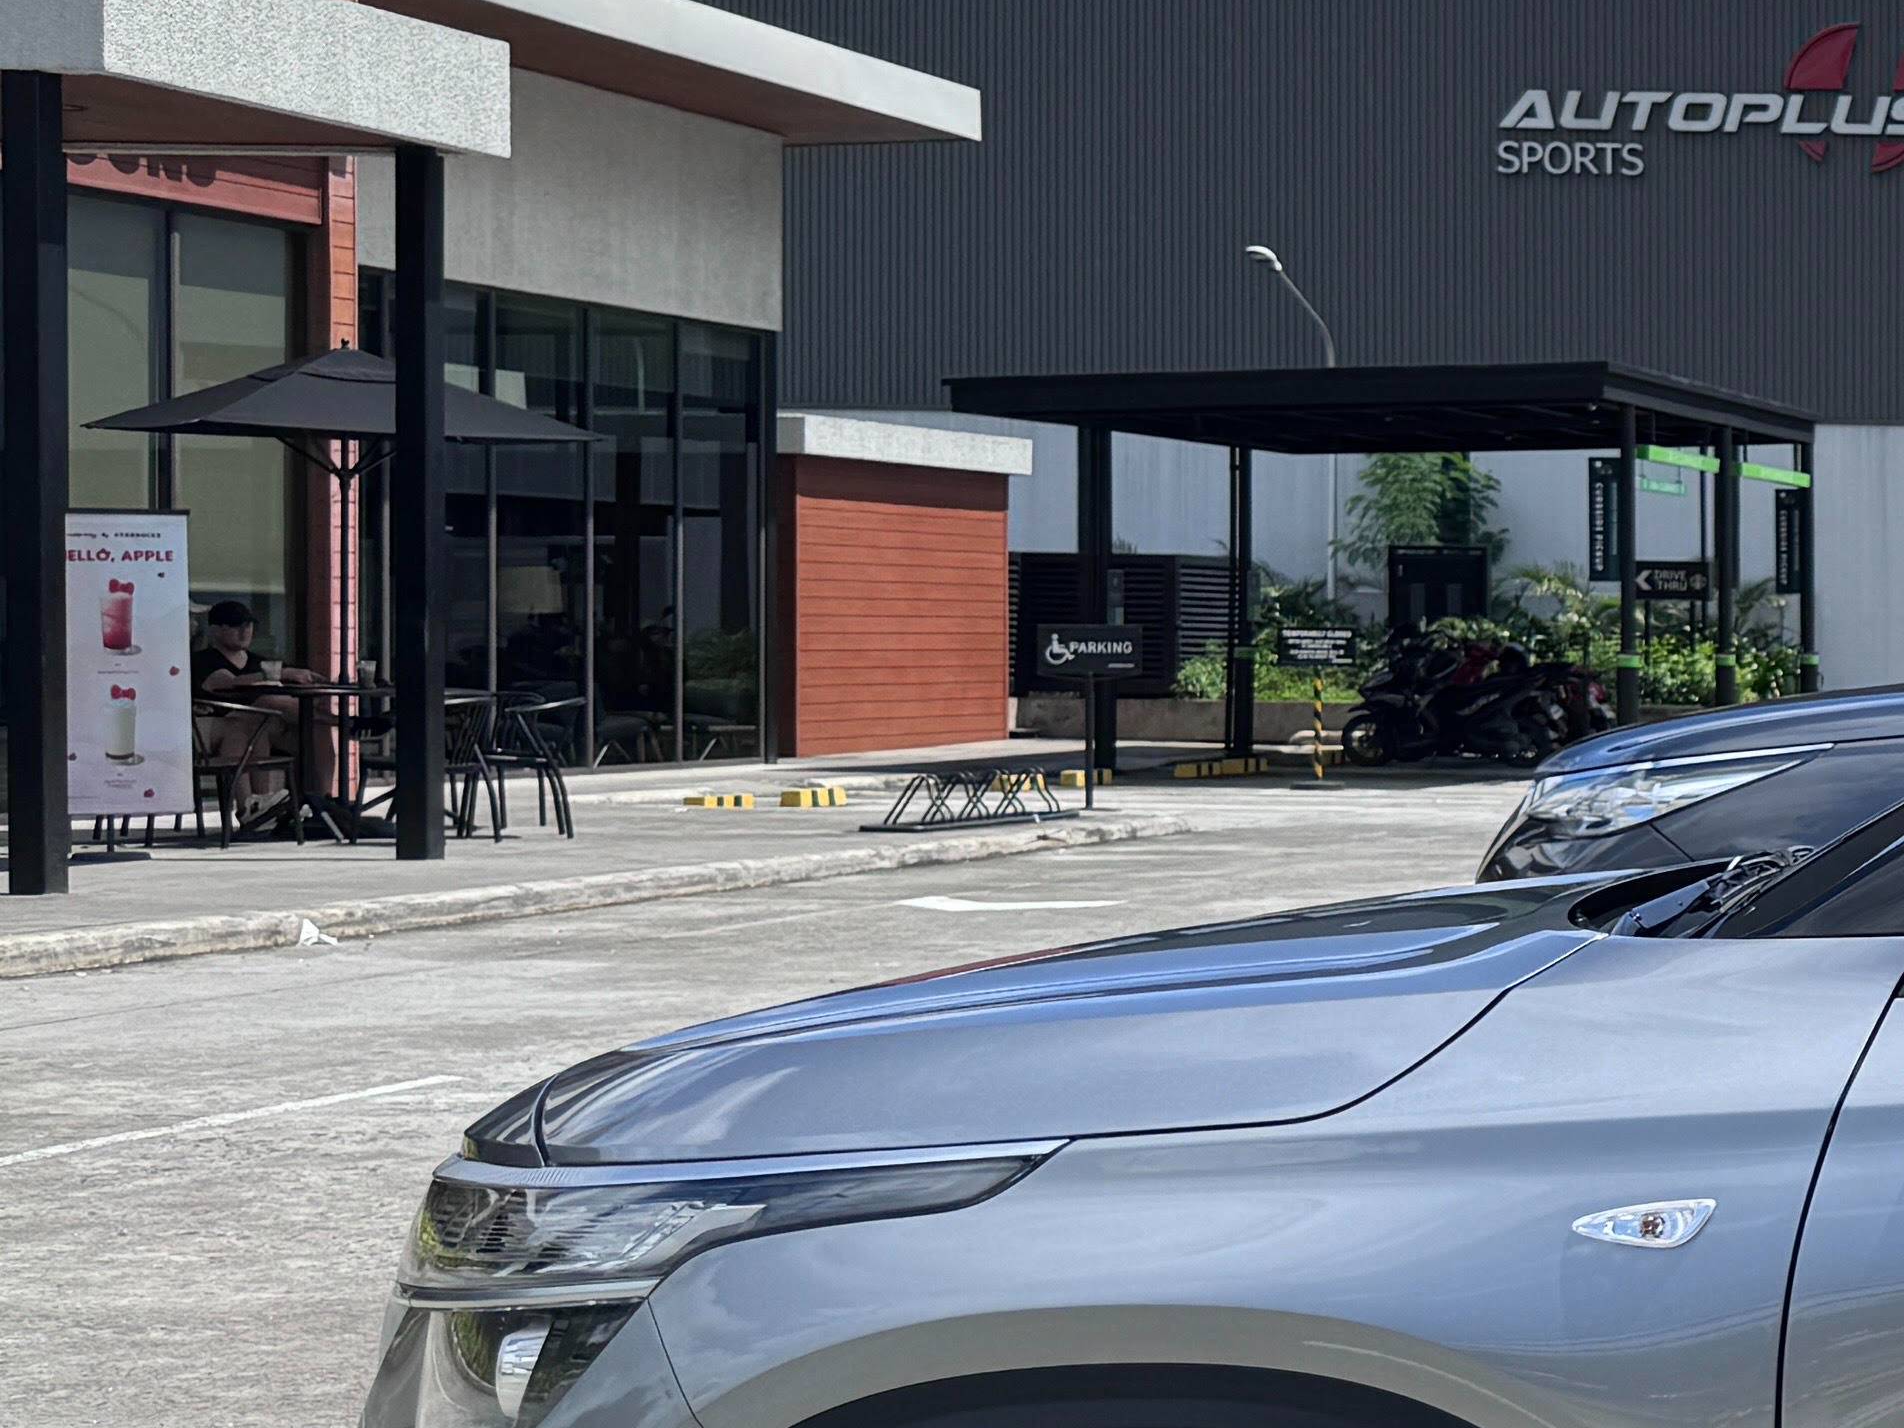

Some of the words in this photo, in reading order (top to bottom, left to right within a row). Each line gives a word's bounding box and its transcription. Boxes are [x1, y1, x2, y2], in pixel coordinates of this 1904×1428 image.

[1496, 140, 1646, 177] SPORTS
[121, 550, 174, 562] APPLE
[1069, 641, 1133, 654] PARKING
